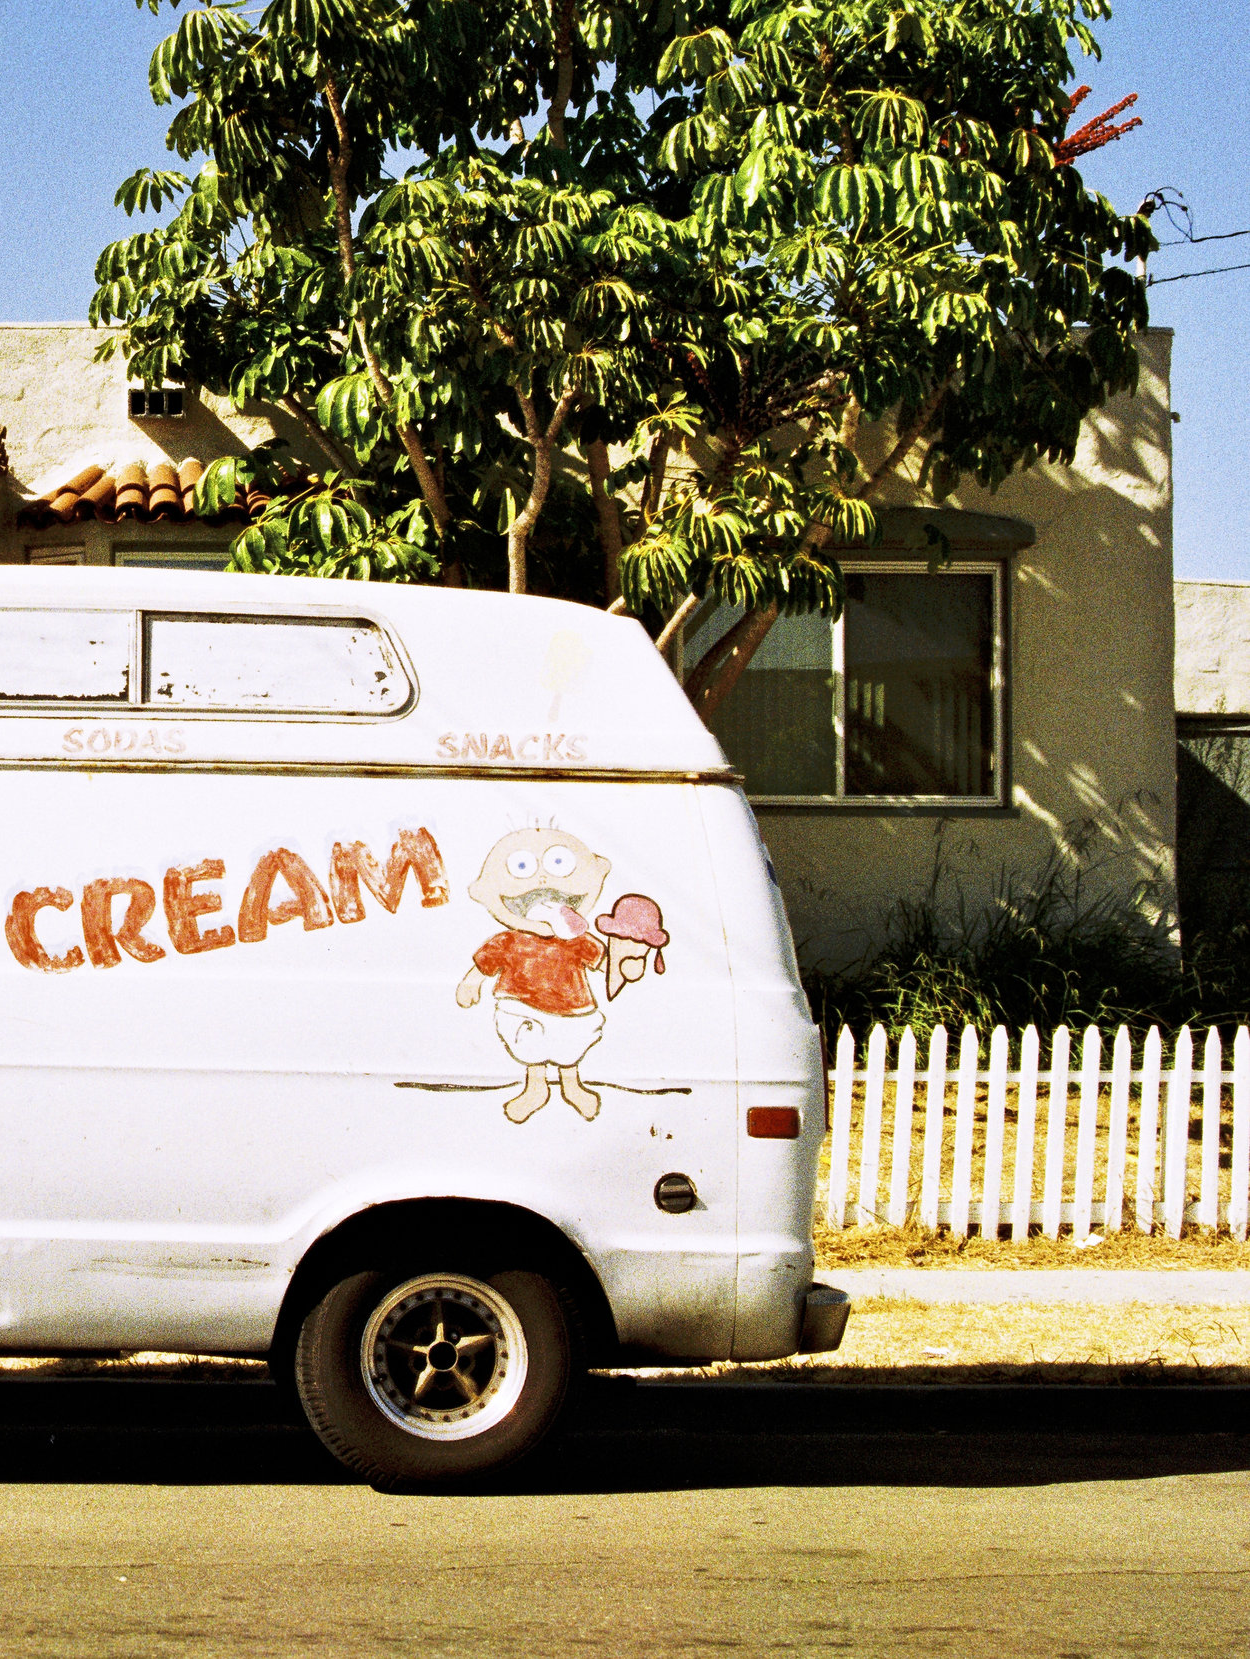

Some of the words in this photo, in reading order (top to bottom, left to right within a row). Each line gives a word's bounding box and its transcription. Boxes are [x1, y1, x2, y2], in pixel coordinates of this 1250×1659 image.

[61, 726, 187, 754] SODAS
[436, 732, 589, 761] SNACKS
[4, 825, 450, 975] CREAM
